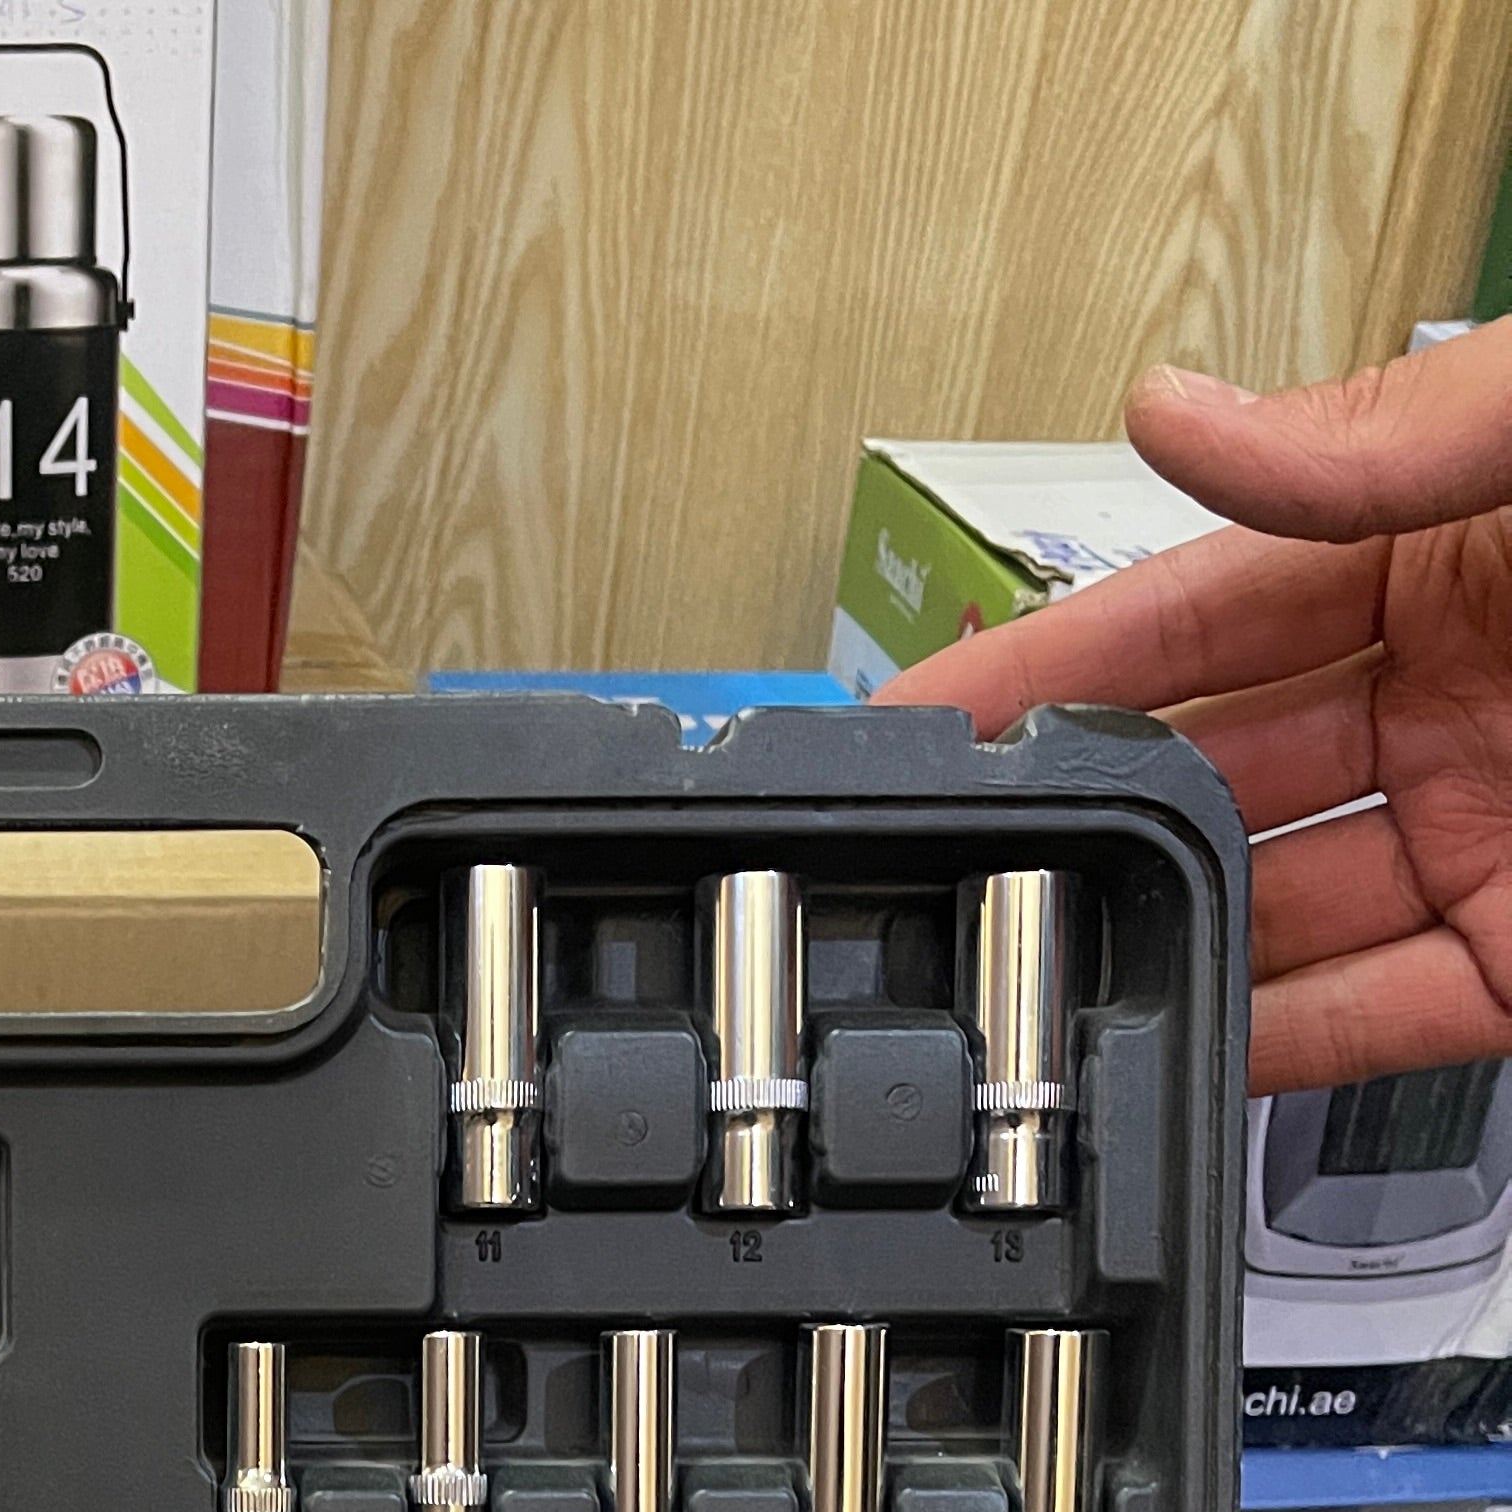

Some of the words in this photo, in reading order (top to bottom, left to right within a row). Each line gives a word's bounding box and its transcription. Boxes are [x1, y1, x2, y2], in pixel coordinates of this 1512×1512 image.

[21, 543, 59, 559] love
[7, 565, 43, 583] 520
[474, 1230, 502, 1262] 11
[729, 1230, 763, 1262] 12
[991, 1230, 1025, 1263] 13
